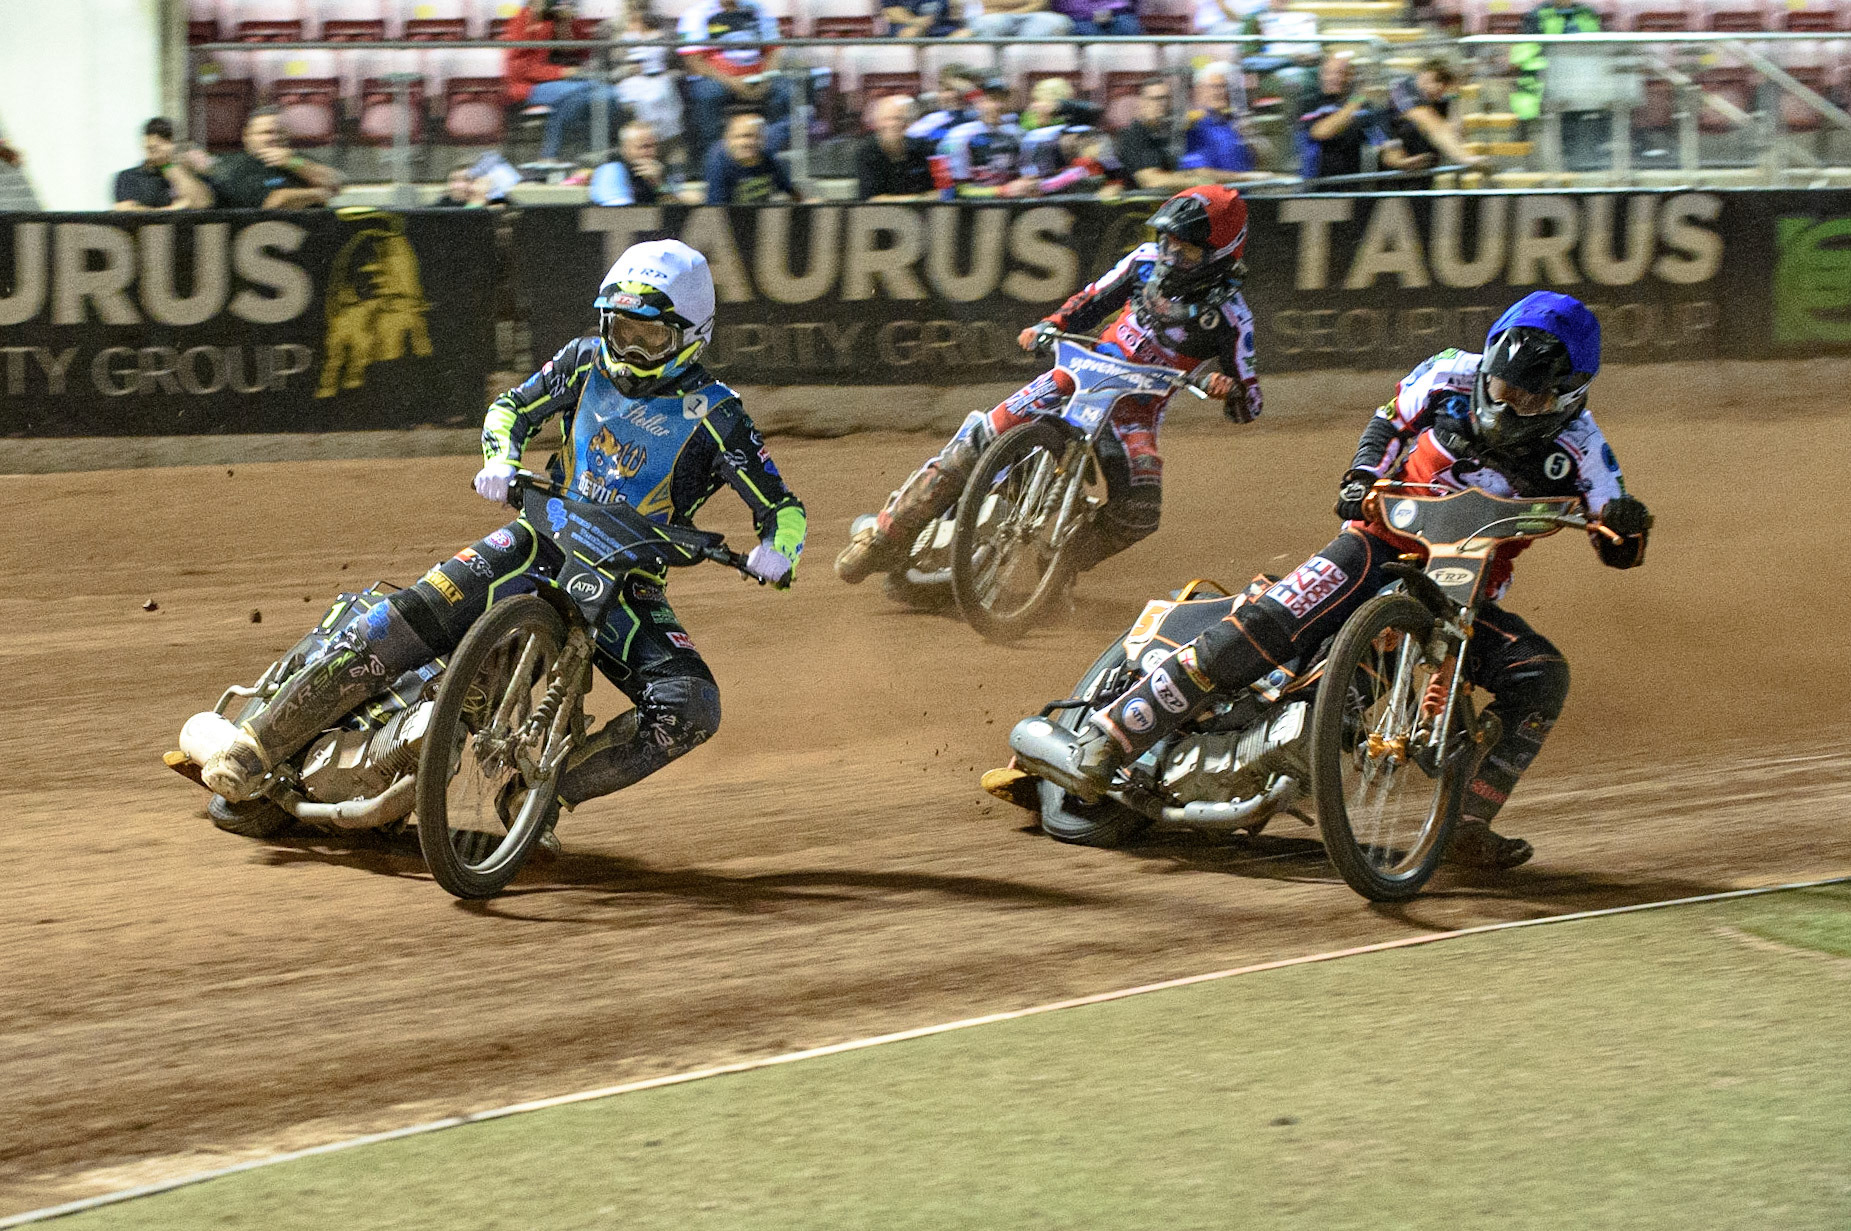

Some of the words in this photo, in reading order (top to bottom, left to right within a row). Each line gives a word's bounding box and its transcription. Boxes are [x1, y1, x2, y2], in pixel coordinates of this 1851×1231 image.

[578, 205, 1080, 302] TAURUS
[1277, 193, 1724, 290] TAURUS
[91, 343, 314, 396] GROUP
[1550, 456, 1566, 476] 5
[572, 581, 597, 595] ATPI
[1434, 571, 1468, 581] FRP
[1290, 567, 1343, 617] SHORING
[322, 601, 347, 628] 1
[1130, 604, 1167, 637] 5
[1129, 706, 1149, 728] ATPI
